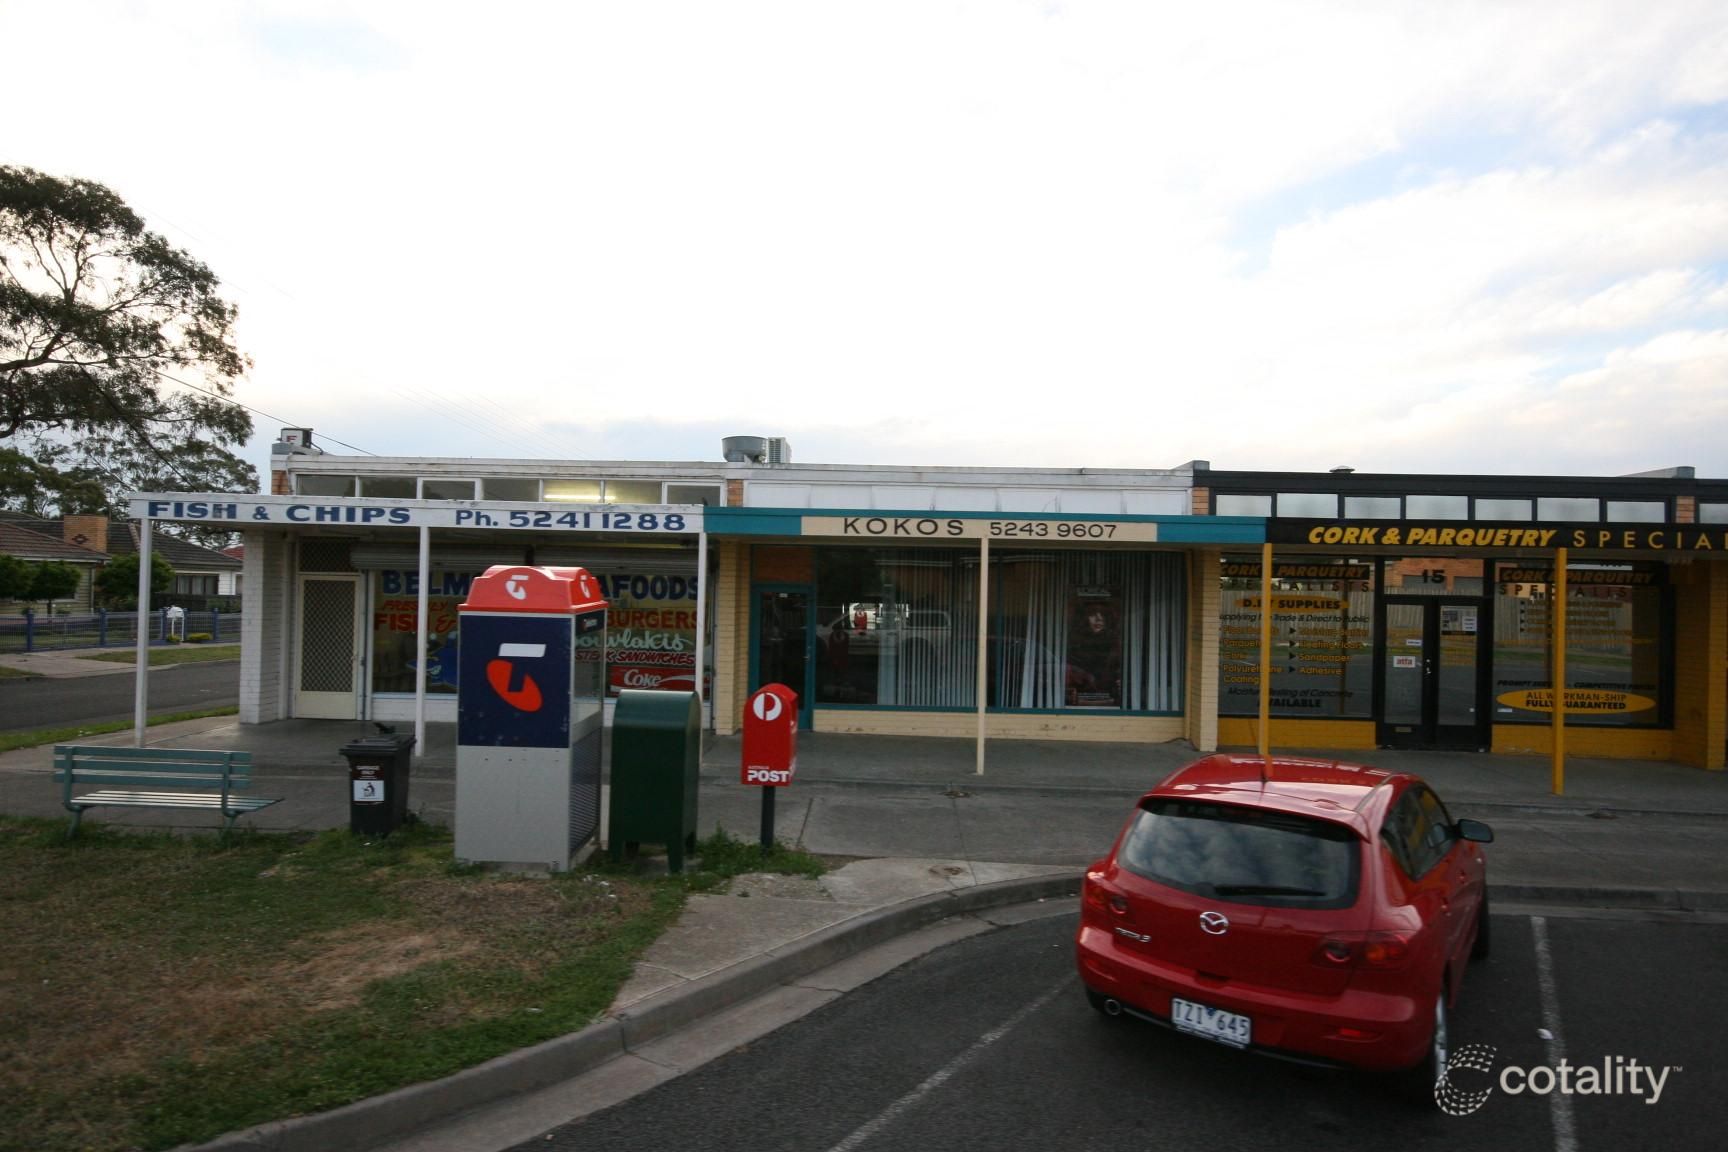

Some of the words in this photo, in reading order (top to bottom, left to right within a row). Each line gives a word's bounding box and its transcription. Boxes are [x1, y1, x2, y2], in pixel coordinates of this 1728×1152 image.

[148, 501, 237, 519] FISH
[252, 506, 271, 520] &
[286, 505, 410, 524] CHIPS
[844, 517, 964, 536] KOKOS
[990, 521, 1049, 537] 5243
[1057, 523, 1117, 539] 9607
[1308, 526, 1380, 545] CORK
[1381, 527, 1401, 545] &
[1407, 528, 1557, 548] PARQUETRY
[1277, 564, 1365, 577] PARQUETRY
[1422, 569, 1445, 583] 15
[383, 570, 471, 595] BELM
[1278, 600, 1341, 610] SUPPLIES
[624, 669, 661, 687] Coke
[1546, 692, 1627, 701] WRKMAN-SHIP
[1564, 700, 1627, 710] UARANTEED
[747, 769, 789, 783] POST
